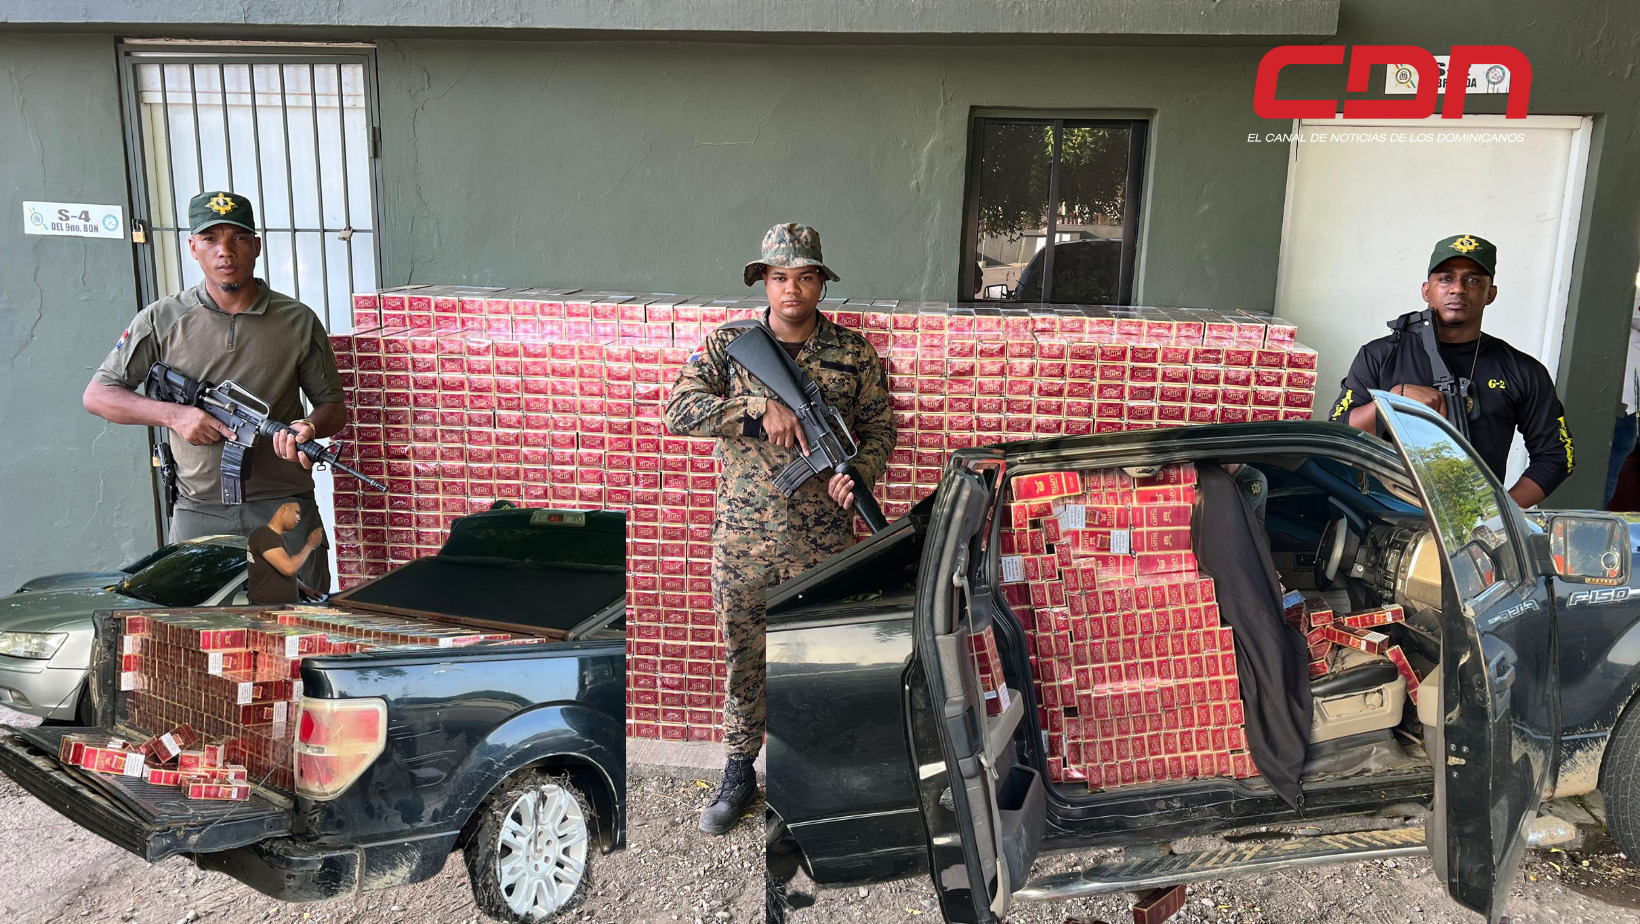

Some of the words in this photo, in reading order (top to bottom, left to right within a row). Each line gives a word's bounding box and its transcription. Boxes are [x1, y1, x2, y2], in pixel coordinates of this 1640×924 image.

[58, 209, 91, 222] S-4
[51, 222, 64, 231] DEL
[66, 223, 82, 232] 9no.
[84, 224, 98, 232] BON
[1488, 379, 1506, 389] G-2
[1567, 586, 1630, 607] F-150
